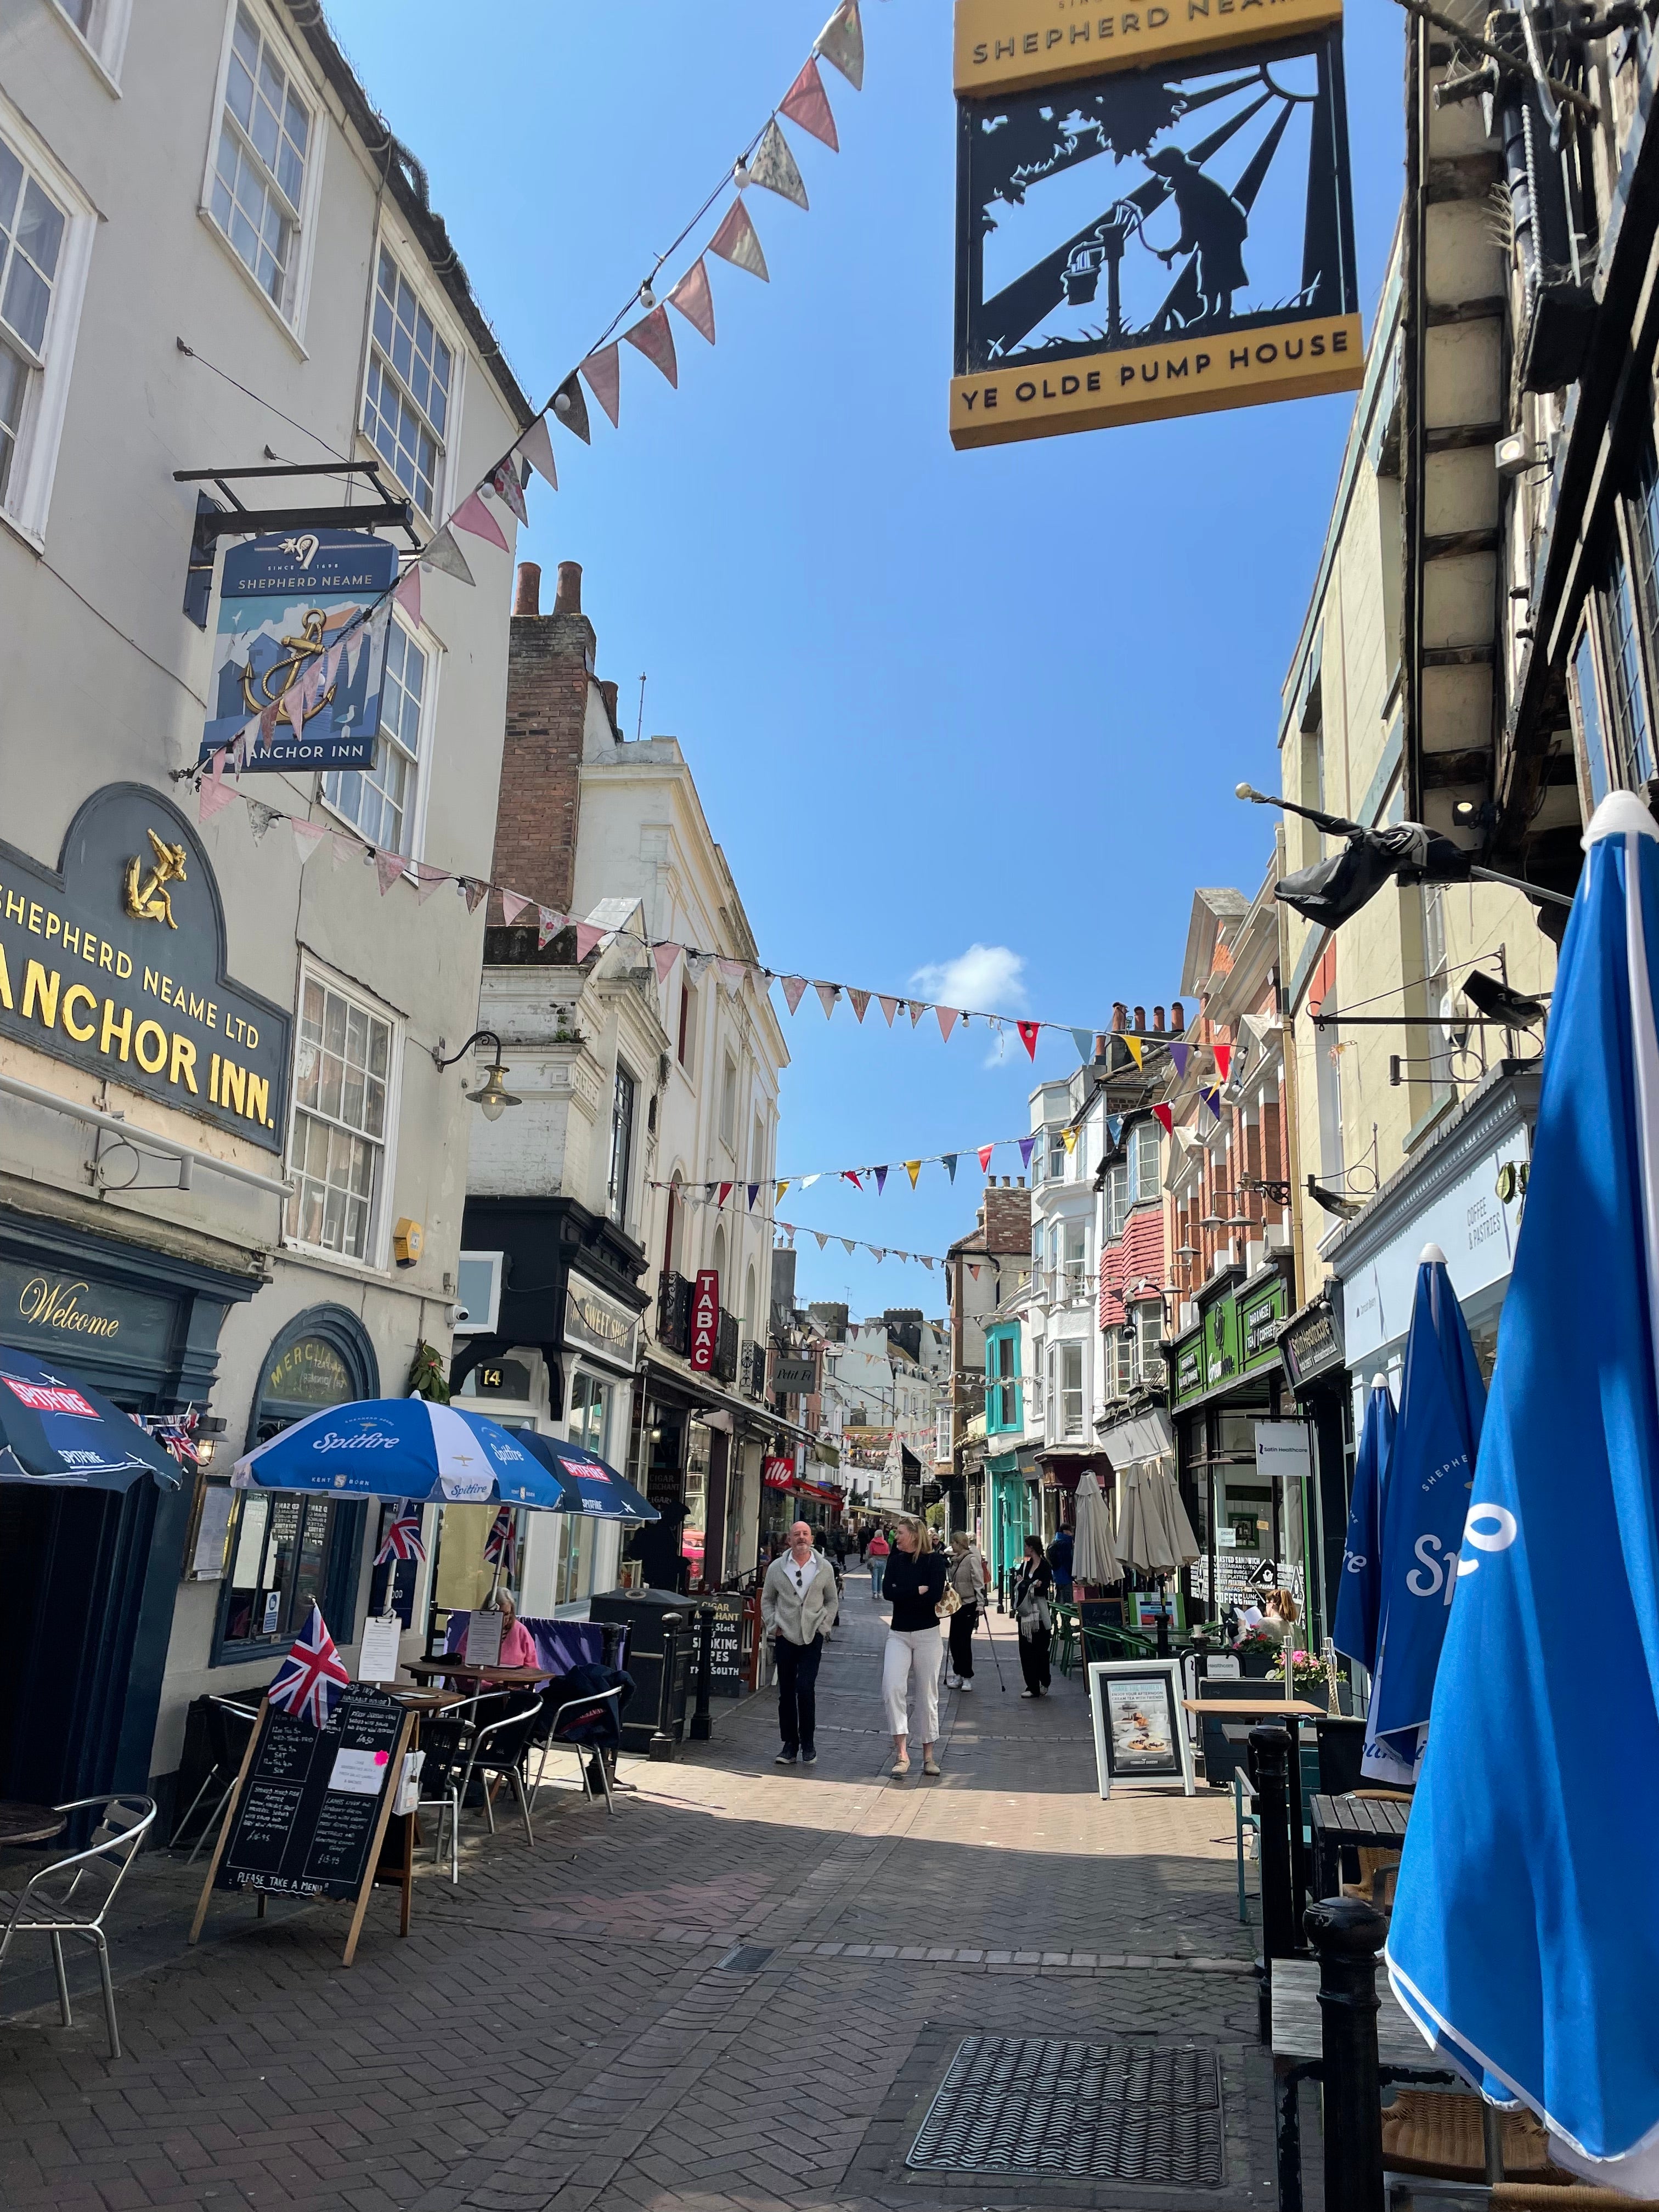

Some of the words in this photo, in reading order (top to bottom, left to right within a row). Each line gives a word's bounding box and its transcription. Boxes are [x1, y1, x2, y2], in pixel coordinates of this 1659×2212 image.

[973, 8, 1169, 65] SHEPHERD
[962, 387, 998, 410] YE
[1015, 371, 1101, 402] OLDE
[1121, 354, 1211, 386] PUMP
[1230, 330, 1349, 369] HOUSE
[238, 577, 317, 590] SHEPHERD
[321, 575, 373, 586] NEAME
[331, 745, 363, 757] INN
[143, 966, 218, 1029] NEAME
[224, 1012, 259, 1050] LTD
[1467, 1197, 1486, 1227] COFFEE
[19, 1278, 120, 1338] Welcome
[583, 1302, 610, 1338] SWEET
[611, 1318, 629, 1348] SHOP
[695, 1277, 714, 1364] TABAC
[484, 1369, 501, 1386] 14
[777, 1368, 798, 1380] Petit
[9, 1381, 94, 1414] SPITFIRE
[312, 1432, 400, 1454] Spitfire
[490, 1443, 524, 1465] Spitfire
[57, 1449, 106, 1465] SPITFIRE
[564, 1461, 608, 1480] SPITFIRE
[765, 1462, 791, 1485] illy
[1422, 1454, 1469, 1492] SHEPHE
[451, 1483, 487, 1498] Spitfire
[582, 1499, 602, 1511] SPITFIRE
[710, 1667, 740, 1676] SOUTH
[236, 1871, 265, 1885] PLEASE
[269, 1876, 289, 1888] TAKE
[291, 1880, 298, 1890] A
[301, 1881, 323, 1892] MENU
